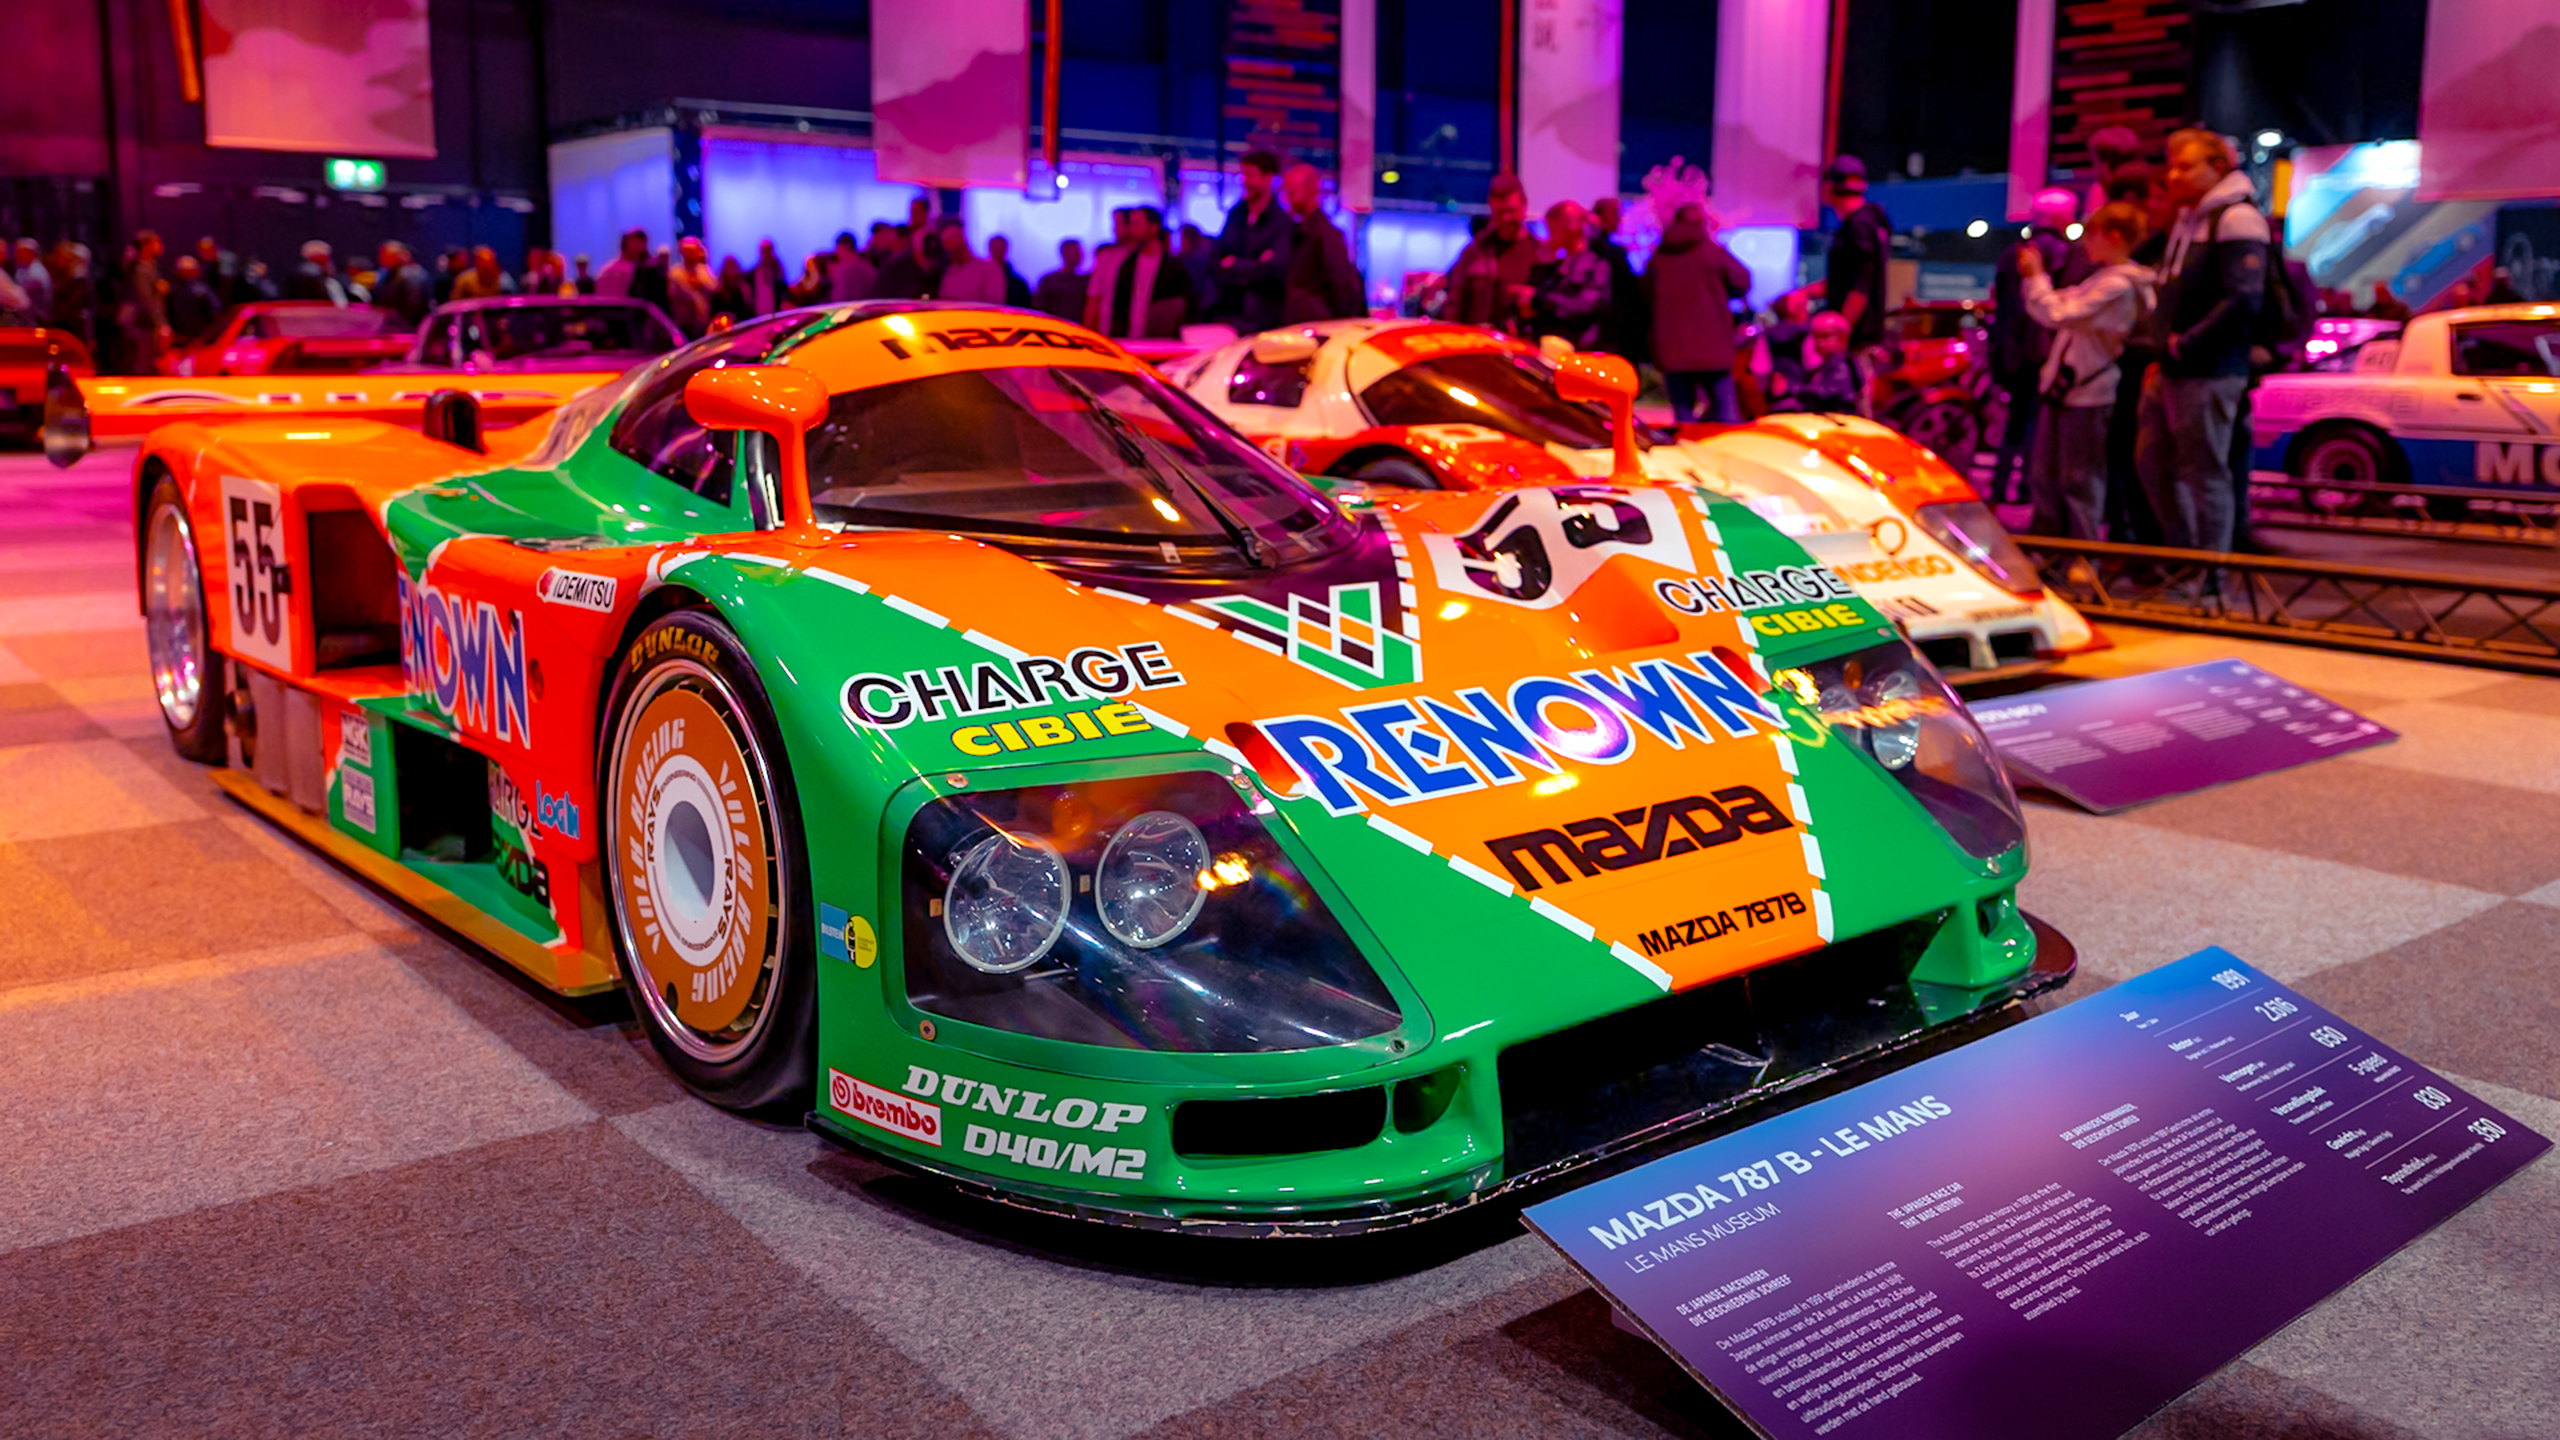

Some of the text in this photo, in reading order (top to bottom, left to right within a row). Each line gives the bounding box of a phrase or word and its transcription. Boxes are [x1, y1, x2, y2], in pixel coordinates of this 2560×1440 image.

[553, 575, 616, 608] IDEMITSU
[1653, 565, 1856, 614] CHARGE
[631, 626, 719, 673] DUNLOP
[841, 641, 1186, 728] CHARGE
[1253, 651, 1790, 817] RENOWN
[647, 784, 662, 862] RAYS
[718, 857, 733, 940] RAYS
[1637, 892, 1807, 957] MAZDA 787B
[2211, 968, 2251, 990] 1991
[2310, 1025, 2348, 1048] 650
[852, 1082, 937, 1136] brembo
[902, 1064, 1147, 1132] DUNLOP
[2414, 1086, 2452, 1110] 830
[963, 1123, 1147, 1180] D40/M2
[2467, 1117, 2507, 1143] 350
[1588, 1184, 1732, 1250] MAZDA
[1718, 1159, 1780, 1198] 787
[1775, 1150, 1812, 1175] B
[1819, 1127, 1871, 1157] LE
[1857, 1095, 1952, 1142] MANS
[1625, 1202, 1782, 1274] LE MANS MUSEUM
[1676, 1269, 1770, 1315] DE JAPANSE RACEWAGEN
[1688, 1274, 1792, 1327] DIE GESCHIEDENIS SCHREEF
